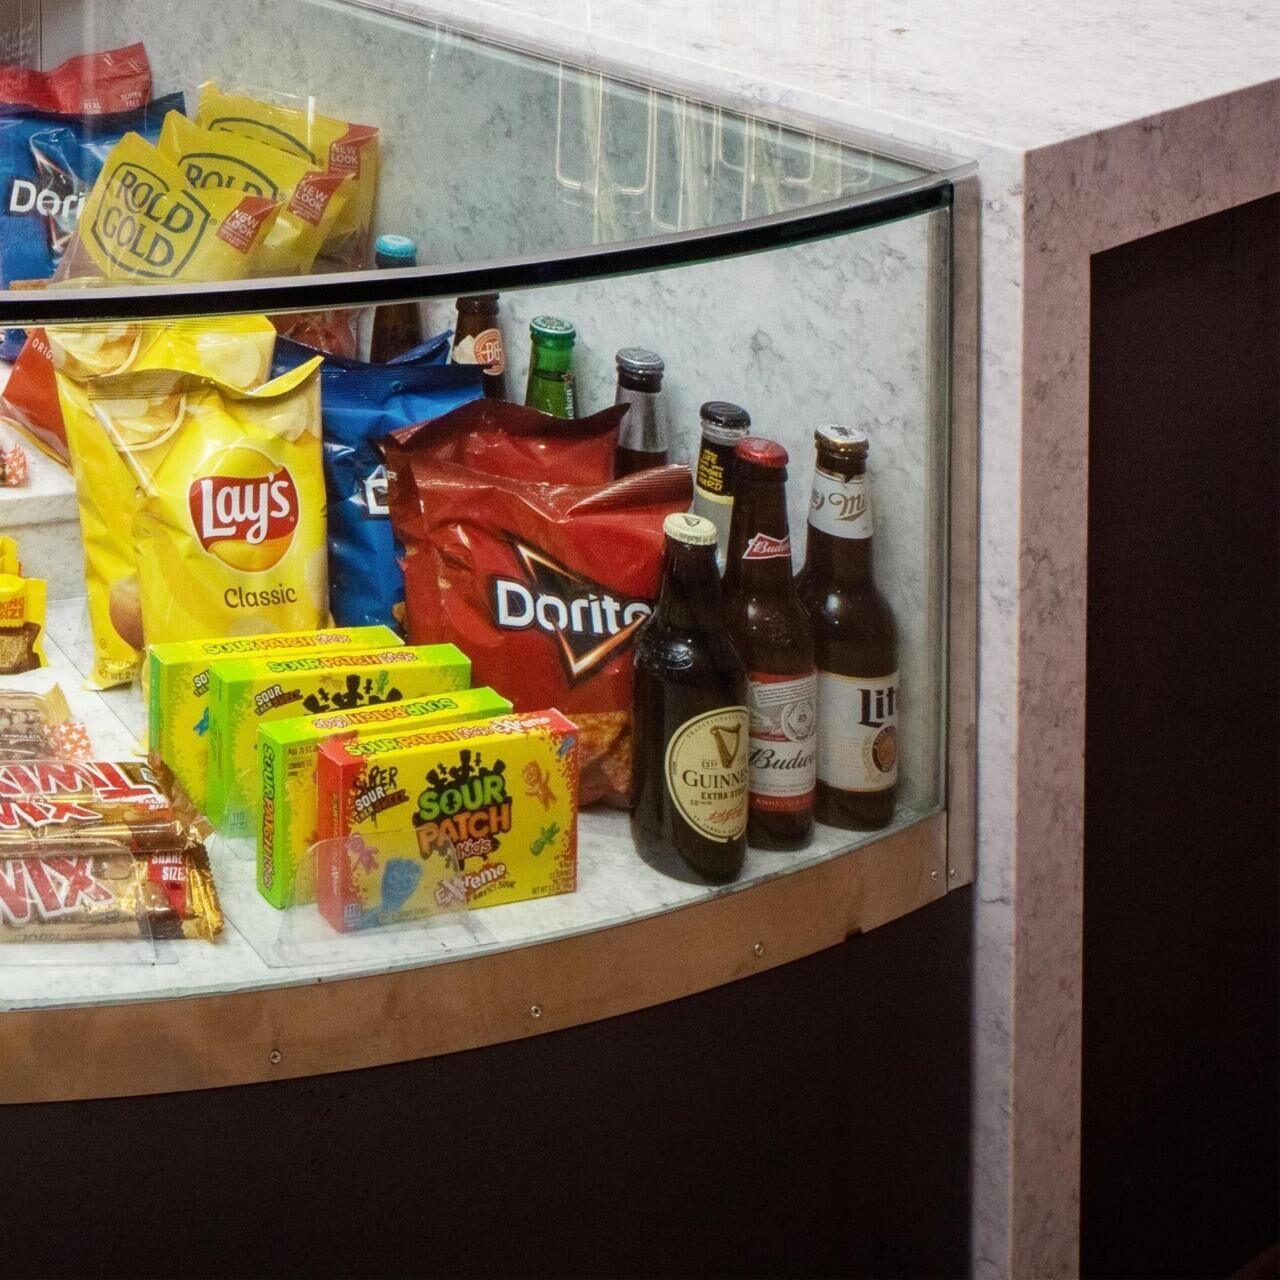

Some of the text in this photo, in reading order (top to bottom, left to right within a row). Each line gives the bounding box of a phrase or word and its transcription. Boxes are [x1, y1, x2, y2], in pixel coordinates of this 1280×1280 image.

[329, 152, 359, 166] LOOK
[331, 142, 358, 155] NEW
[9, 179, 86, 220] Dori
[114, 169, 195, 234] ROLD
[294, 190, 323, 212] LOOK
[298, 181, 328, 202] NEW
[225, 218, 256, 239] LOOK
[231, 208, 260, 230] NEW
[102, 206, 176, 268] GOLD
[199, 471, 292, 544] Lay's
[0, 597, 25, 611] KING
[224, 582, 298, 610] Classic
[496, 579, 652, 636] Dorito
[202, 635, 317, 656] SOUR PATCH
[267, 654, 382, 672] SOUR PATCH
[255, 684, 282, 705] SOUR
[347, 698, 458, 726] SOUR PATCH
[858, 686, 897, 729] Lit
[343, 737, 401, 757] SOUR
[399, 730, 458, 749] PATCH
[262, 742, 276, 859] SOUR PATCH
[355, 786, 387, 810] SOUR
[418, 774, 507, 821] SOUR
[701, 789, 729, 801] EXTRA
[417, 800, 513, 858] PATCH
[456, 837, 491, 862] Kids
[162, 867, 186, 880] SIZE
